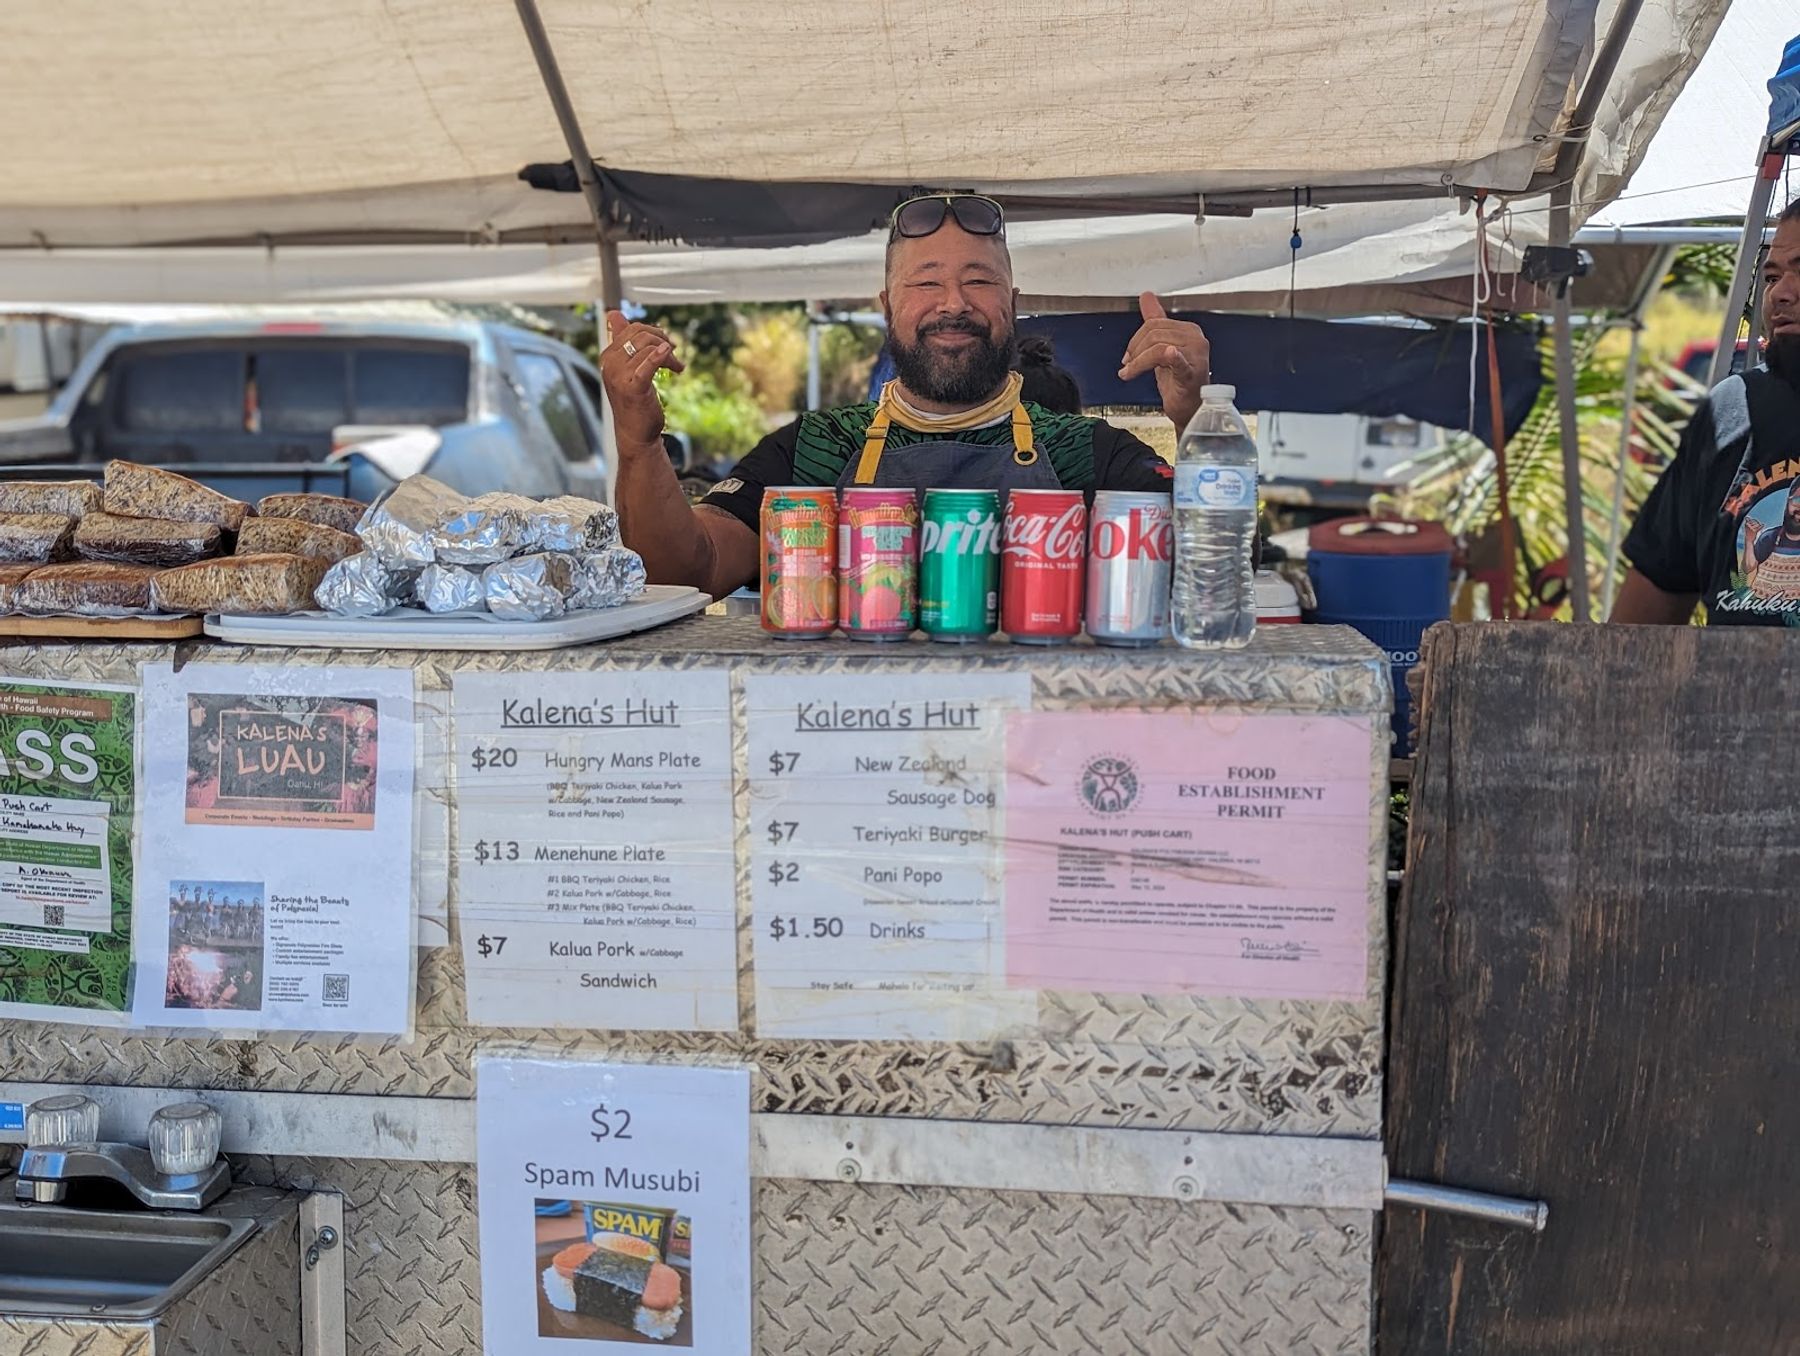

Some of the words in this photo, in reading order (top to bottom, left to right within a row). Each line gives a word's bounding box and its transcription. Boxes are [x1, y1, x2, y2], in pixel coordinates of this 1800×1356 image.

[1091, 505, 1173, 561] oke
[13, 696, 38, 704] Hawaii
[15, 704, 34, 712] Food
[36, 706, 59, 714] Safety
[61, 708, 94, 717] Program
[502, 698, 614, 726] Kalena's
[626, 700, 680, 725] Hut
[796, 701, 913, 729] Kalena's
[924, 702, 980, 728] Hut
[237, 723, 327, 742] KALENA'S
[236, 744, 326, 776] LUAU
[471, 747, 518, 771] $20
[545, 752, 605, 773] Hungry
[610, 752, 654, 768] Mans
[659, 751, 701, 769] Plate
[768, 751, 801, 776] $7
[855, 756, 894, 772] New
[1227, 766, 1277, 781] FOOD
[887, 790, 957, 809] Sausage
[964, 789, 996, 808] Dog
[1178, 784, 1326, 801] ESTABLISHMENT
[2, 798, 25, 811] Push
[30, 802, 52, 812] Cart
[602, 810, 624, 819] Popo)
[1217, 804, 1286, 819] PERMIT
[767, 821, 799, 845] $7
[853, 826, 922, 846] Teriyaki
[929, 826, 988, 848] Burger
[1060, 828, 1107, 837] KALENA'S
[1110, 829, 1128, 837] HUT
[1131, 829, 1160, 838] (PUSH
[1162, 830, 1192, 839] CART)
[474, 840, 520, 865] $13
[534, 846, 618, 862] Menehune
[623, 846, 666, 862] Plate
[561, 876, 580, 884] BBQ
[583, 876, 615, 886] Teriyaki
[617, 876, 652, 884] Chicken,
[768, 861, 801, 886] $2
[864, 867, 898, 883] Pani
[903, 867, 943, 887] Popo
[270, 895, 302, 905] Sharing
[320, 896, 350, 906] Beauty
[602, 904, 624, 912] (BBQ
[627, 904, 660, 913] Teriyaki
[675, 918, 696, 926] Rice)
[770, 917, 844, 942] $1.50
[870, 922, 925, 940] Drinks
[477, 936, 508, 959] $7
[550, 941, 592, 957] Kalua
[598, 941, 635, 957] Pork
[639, 949, 683, 958] w/Cabbage
[580, 973, 657, 990] Sandwich
[810, 982, 831, 990] Stay
[833, 982, 854, 990] Safe
[591, 1103, 633, 1142] $2
[524, 1162, 594, 1192] Spam
[604, 1166, 700, 1192] Musubi
[592, 1208, 662, 1240] SPAM
